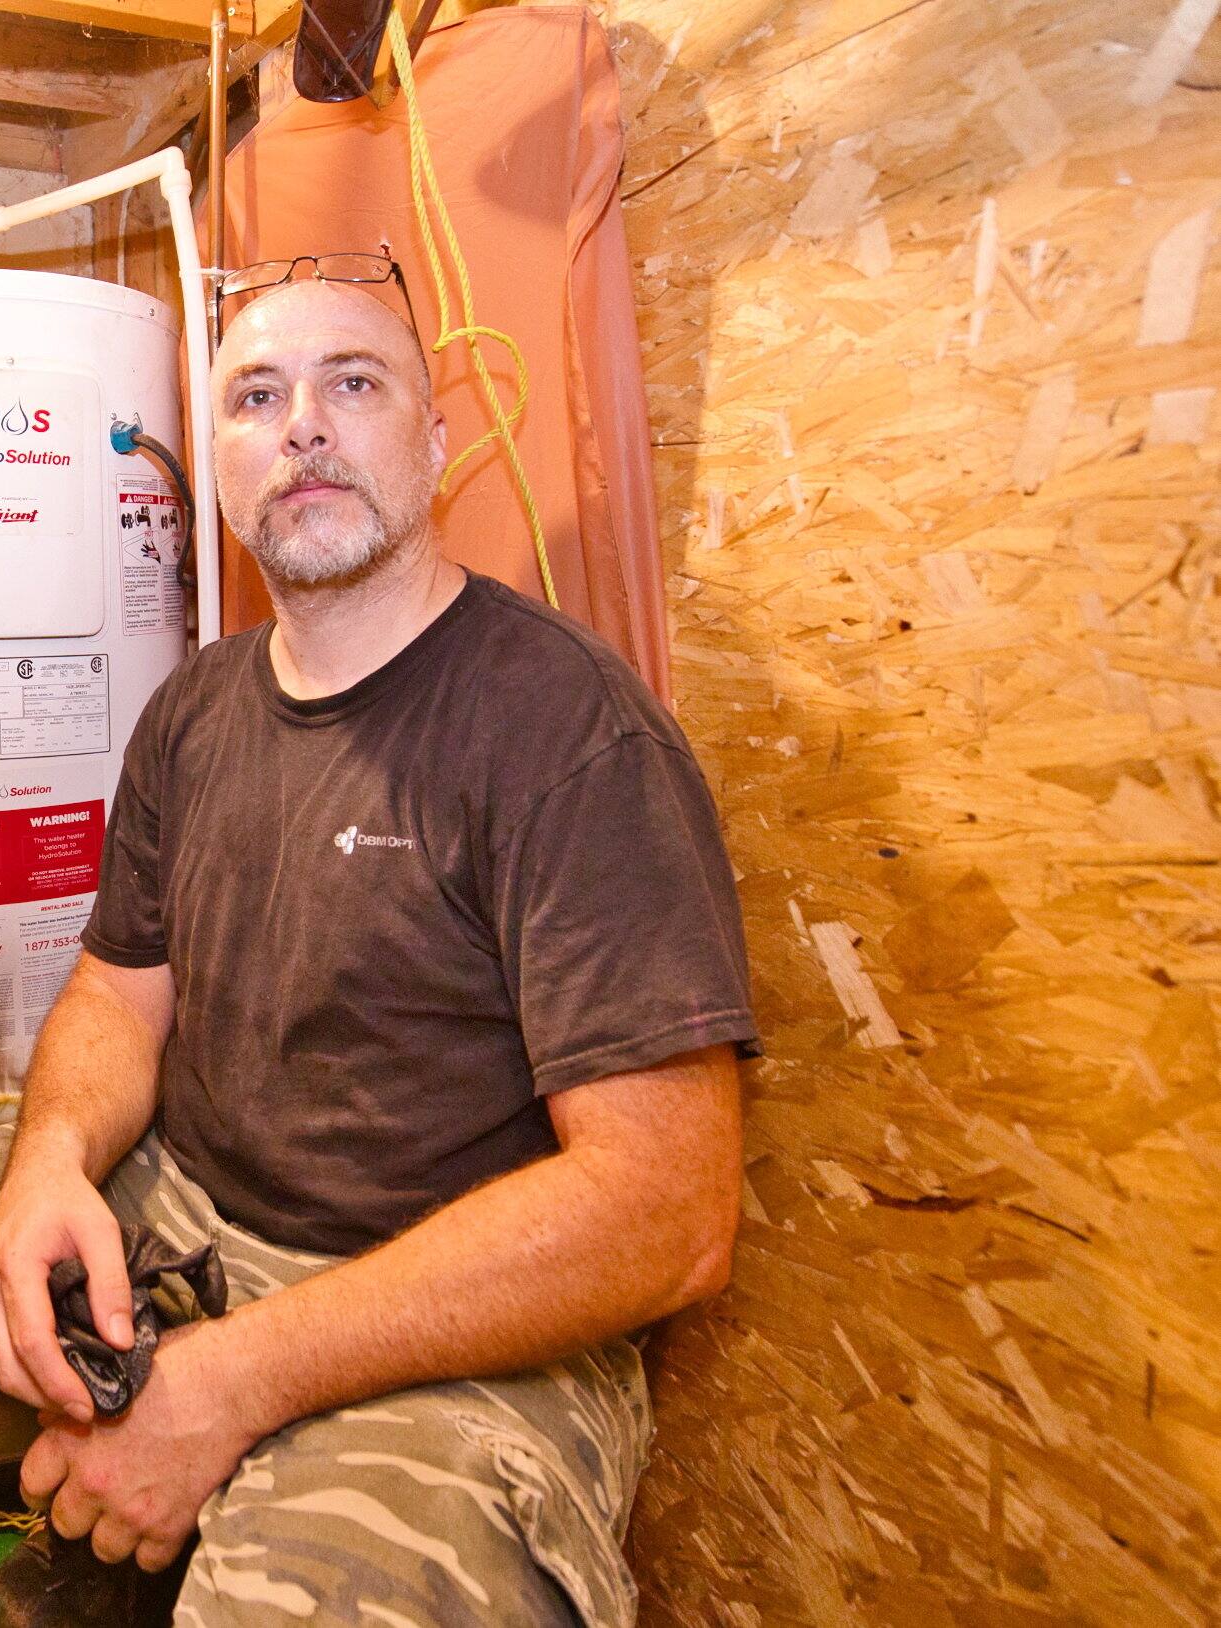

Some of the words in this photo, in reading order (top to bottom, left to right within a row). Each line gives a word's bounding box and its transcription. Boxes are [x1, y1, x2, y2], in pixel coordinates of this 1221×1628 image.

[133, 495, 154, 503] DANGER
[10, 785, 52, 797] Solution
[30, 811, 90, 828] WARNING!
[44, 843, 68, 852] belongs
[38, 849, 82, 860] HydroSolution
[25, 942, 30, 952] 1
[31, 940, 50, 951] 877
[52, 935, 80, 948] 353-0
